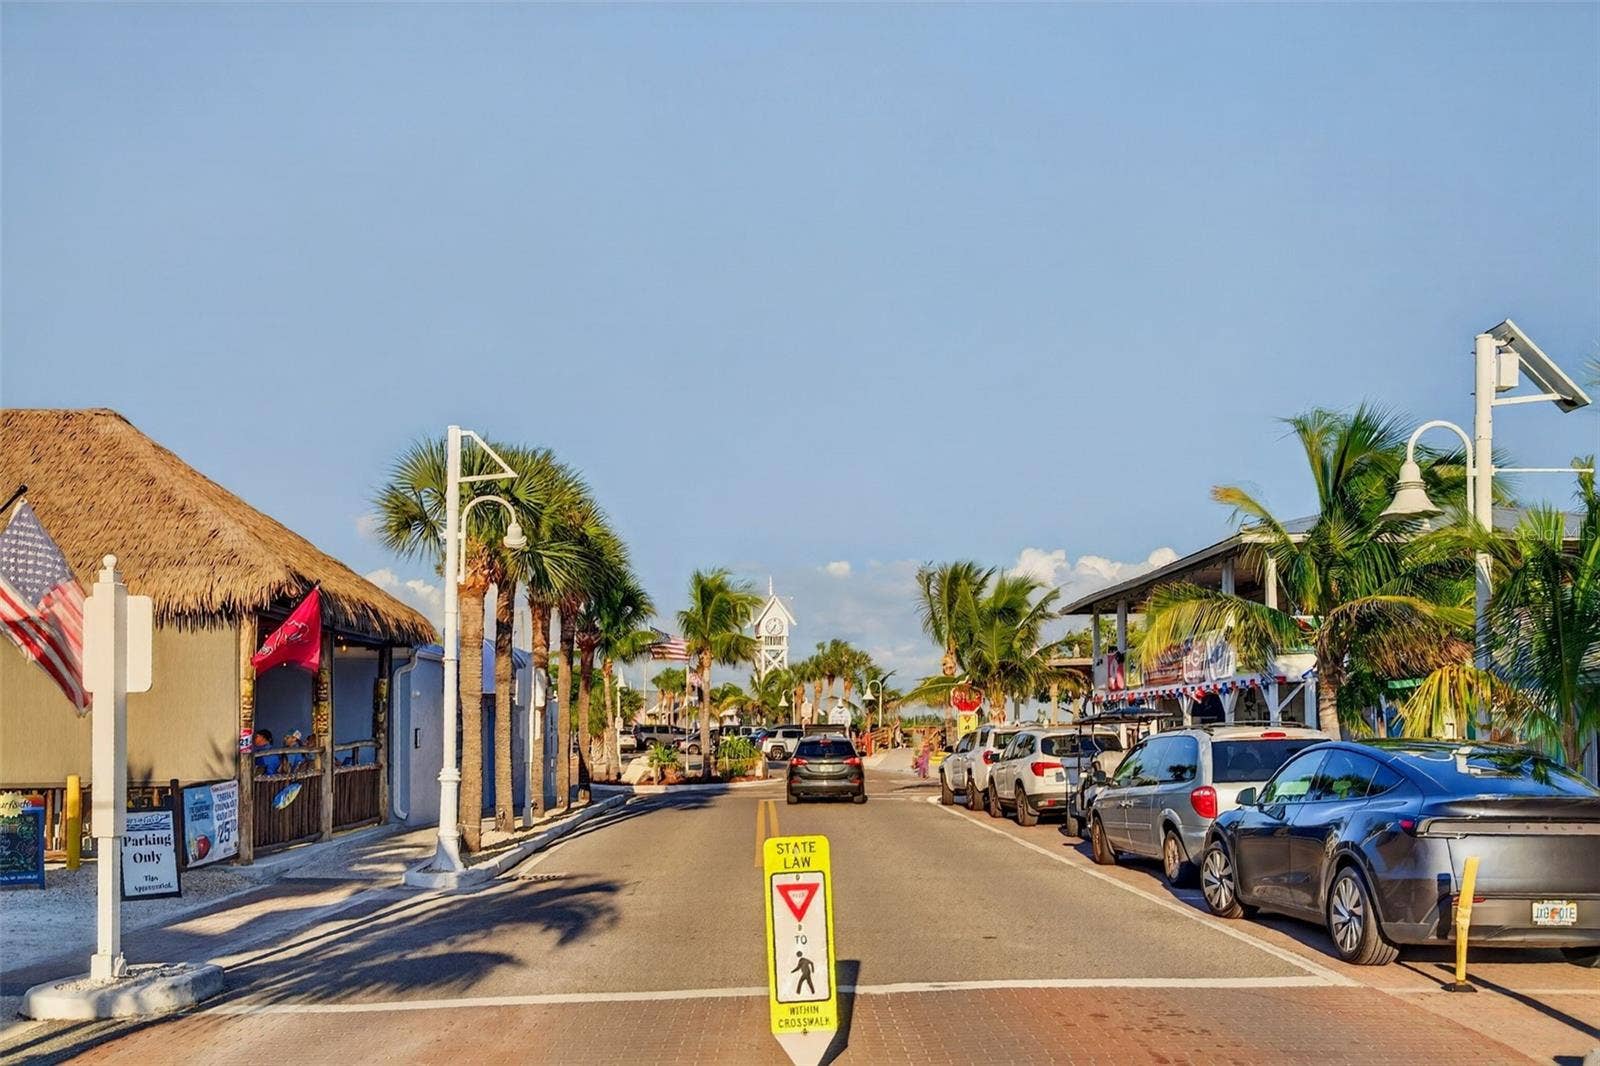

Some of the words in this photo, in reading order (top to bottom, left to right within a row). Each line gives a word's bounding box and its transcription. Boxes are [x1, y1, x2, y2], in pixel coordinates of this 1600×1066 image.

[123, 833, 172, 847] Parking
[776, 842, 816, 855] STATE
[133, 851, 162, 864] Only
[784, 856, 811, 869] LAW
[794, 935, 808, 945] TO
[789, 1006, 820, 1016] WITHIN
[778, 1016, 831, 1028] CROSSWALK
